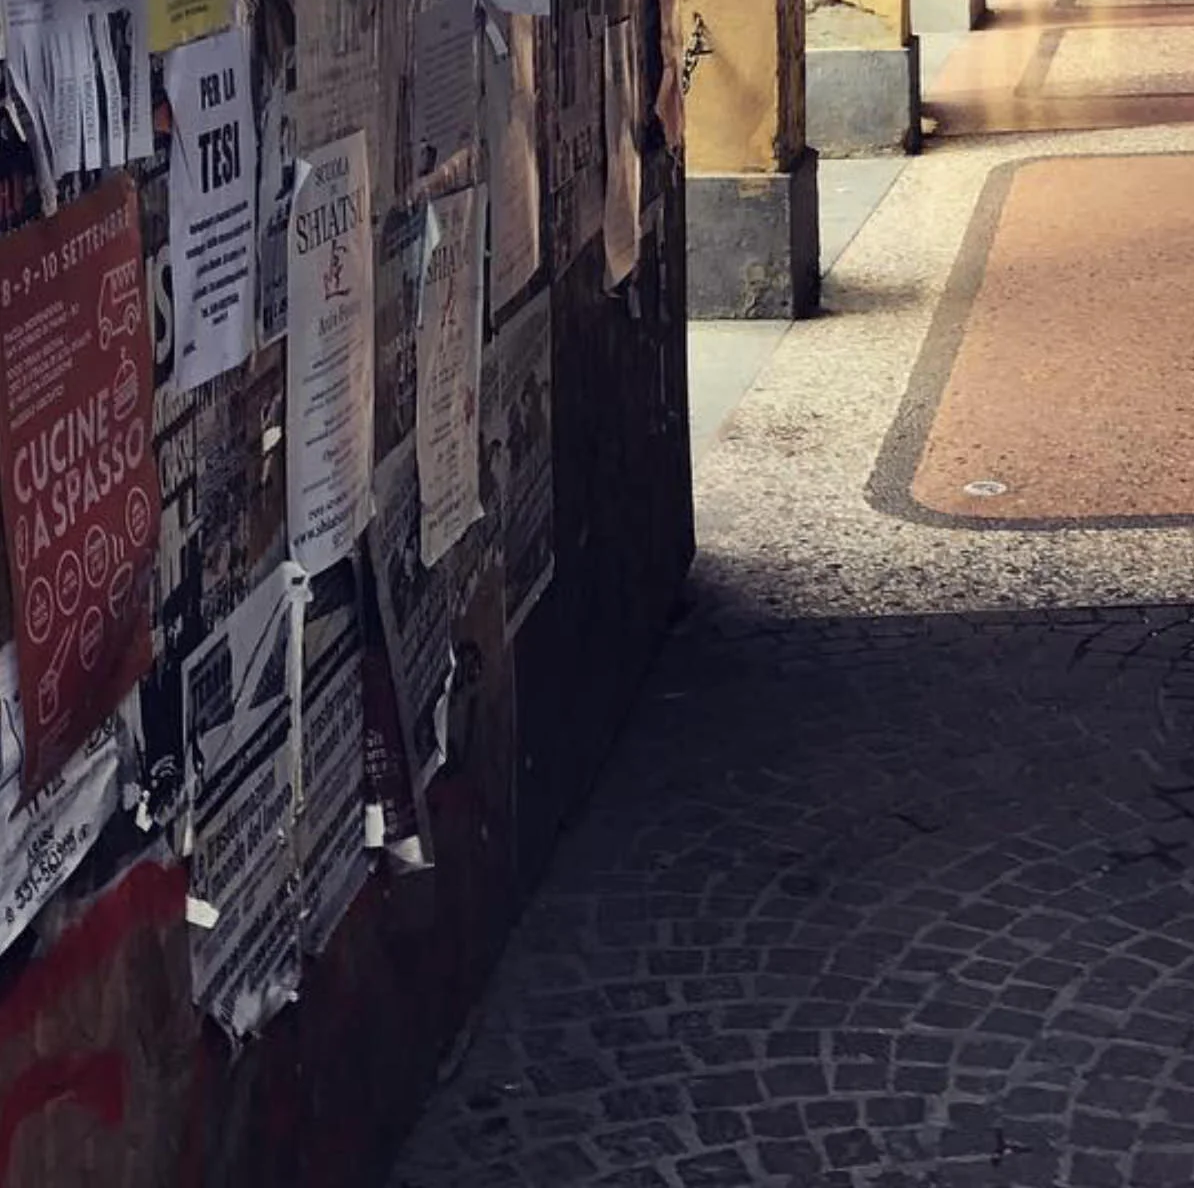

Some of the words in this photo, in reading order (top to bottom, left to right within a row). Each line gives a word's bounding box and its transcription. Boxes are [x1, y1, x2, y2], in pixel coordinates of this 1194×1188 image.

[201, 74, 222, 110] PER
[198, 120, 242, 193] TESI
[13, 387, 111, 505] CUCINE
[32, 496, 52, 561] A
[52, 415, 146, 538] SPASSO
